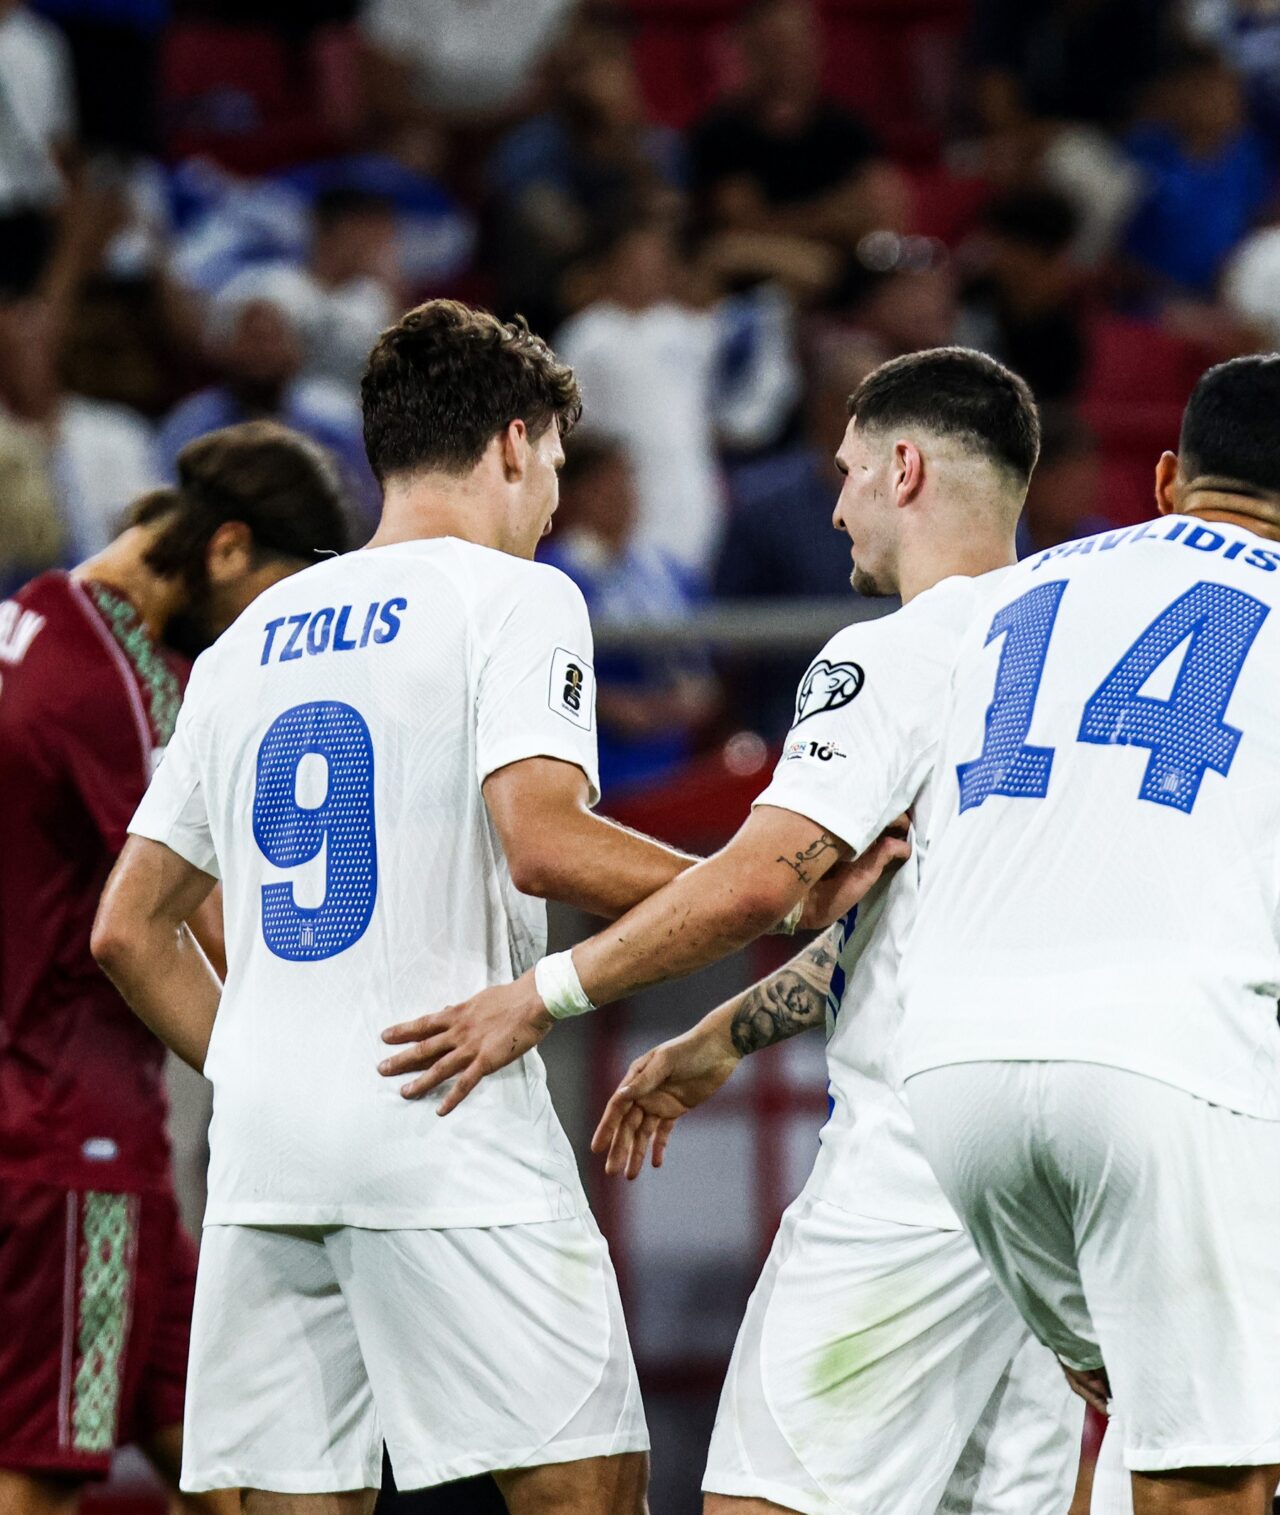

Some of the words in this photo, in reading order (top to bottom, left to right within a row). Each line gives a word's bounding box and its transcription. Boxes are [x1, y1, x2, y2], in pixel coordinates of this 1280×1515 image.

[260, 597, 408, 666] TZOLIS
[955, 578, 1272, 815] 14
[251, 699, 379, 963] 9
